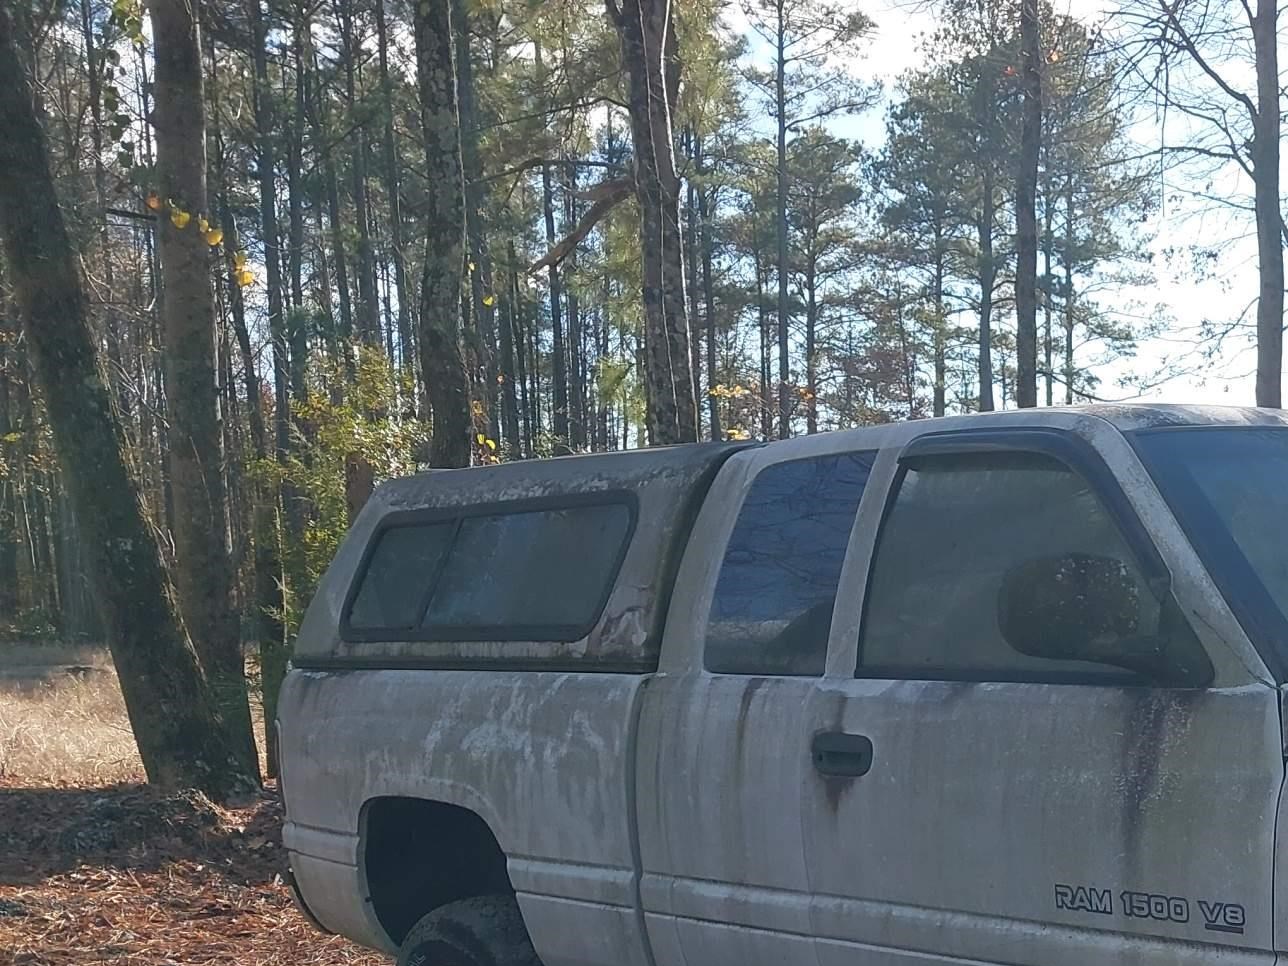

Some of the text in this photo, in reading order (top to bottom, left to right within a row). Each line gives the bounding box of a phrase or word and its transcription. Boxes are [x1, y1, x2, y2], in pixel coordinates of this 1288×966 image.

[1055, 884, 1245, 926] RAM 1500 V8
